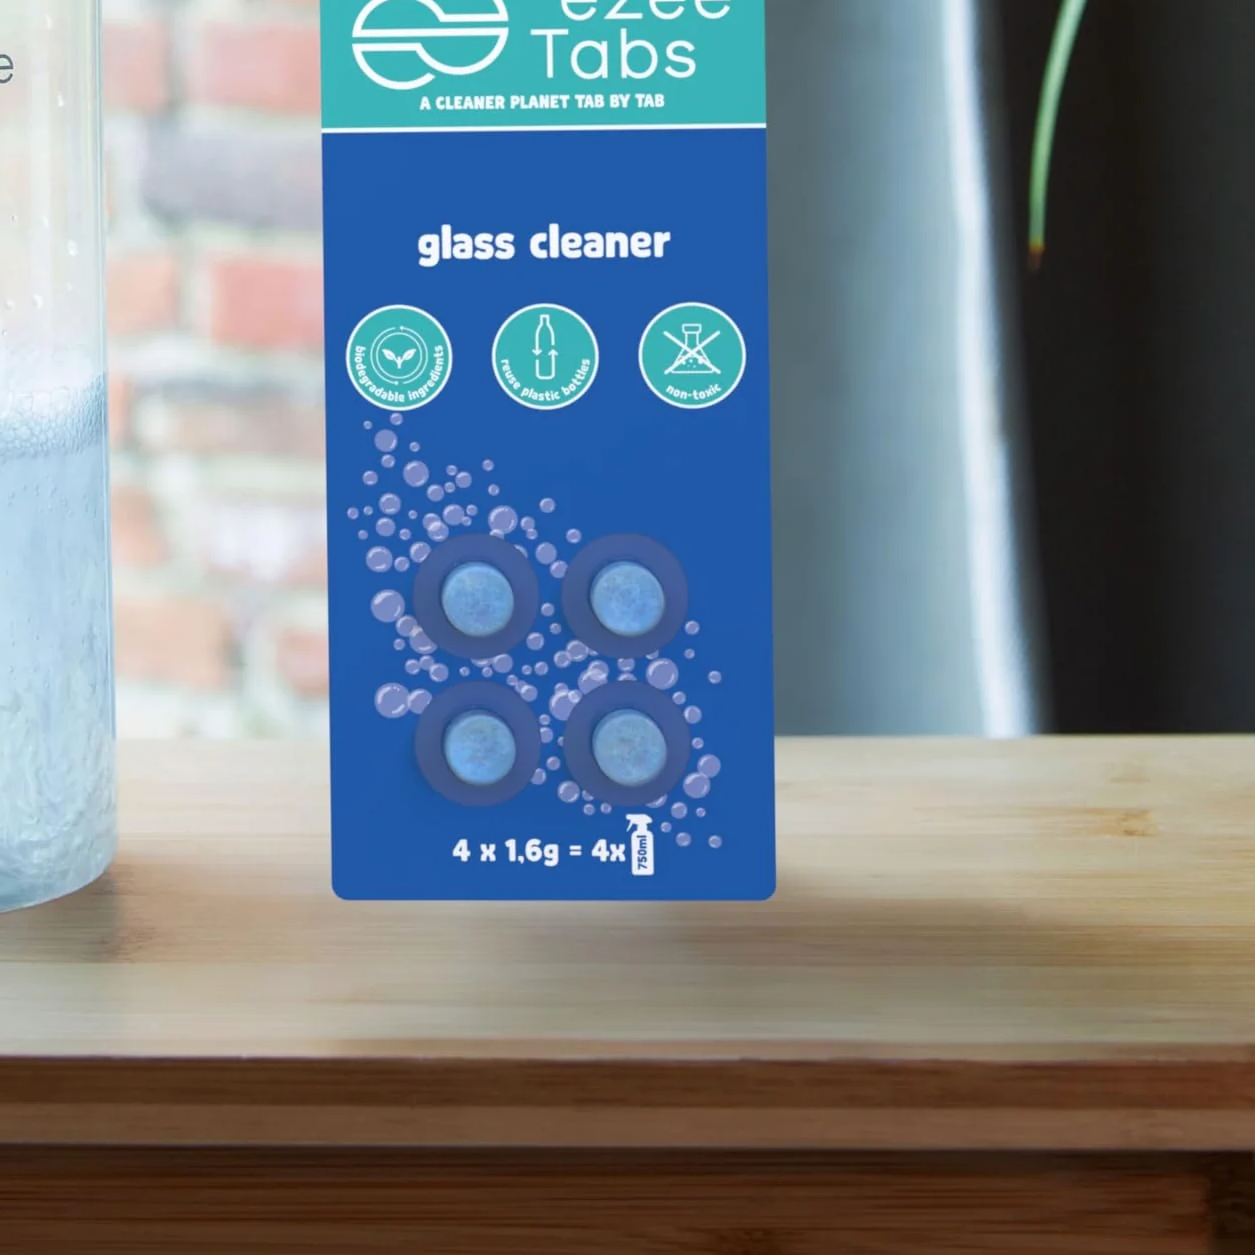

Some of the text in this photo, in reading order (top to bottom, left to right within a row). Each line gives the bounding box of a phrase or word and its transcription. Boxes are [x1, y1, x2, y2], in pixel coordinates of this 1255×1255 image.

[530, 28, 697, 80] Tabs
[419, 93, 665, 110] A CLEANER PLANET TAB BY TAB
[417, 223, 671, 267] glass cleaner
[354, 345, 444, 402] biodegradable ingredients
[500, 358, 590, 401] reuse plastic bottles
[666, 384, 722, 400] non-toxic
[452, 838, 471, 862] 4
[480, 843, 496, 862] x
[504, 838, 559, 867] 1,6g
[591, 838, 626, 862] 4x
[637, 835, 648, 870] 750ml
